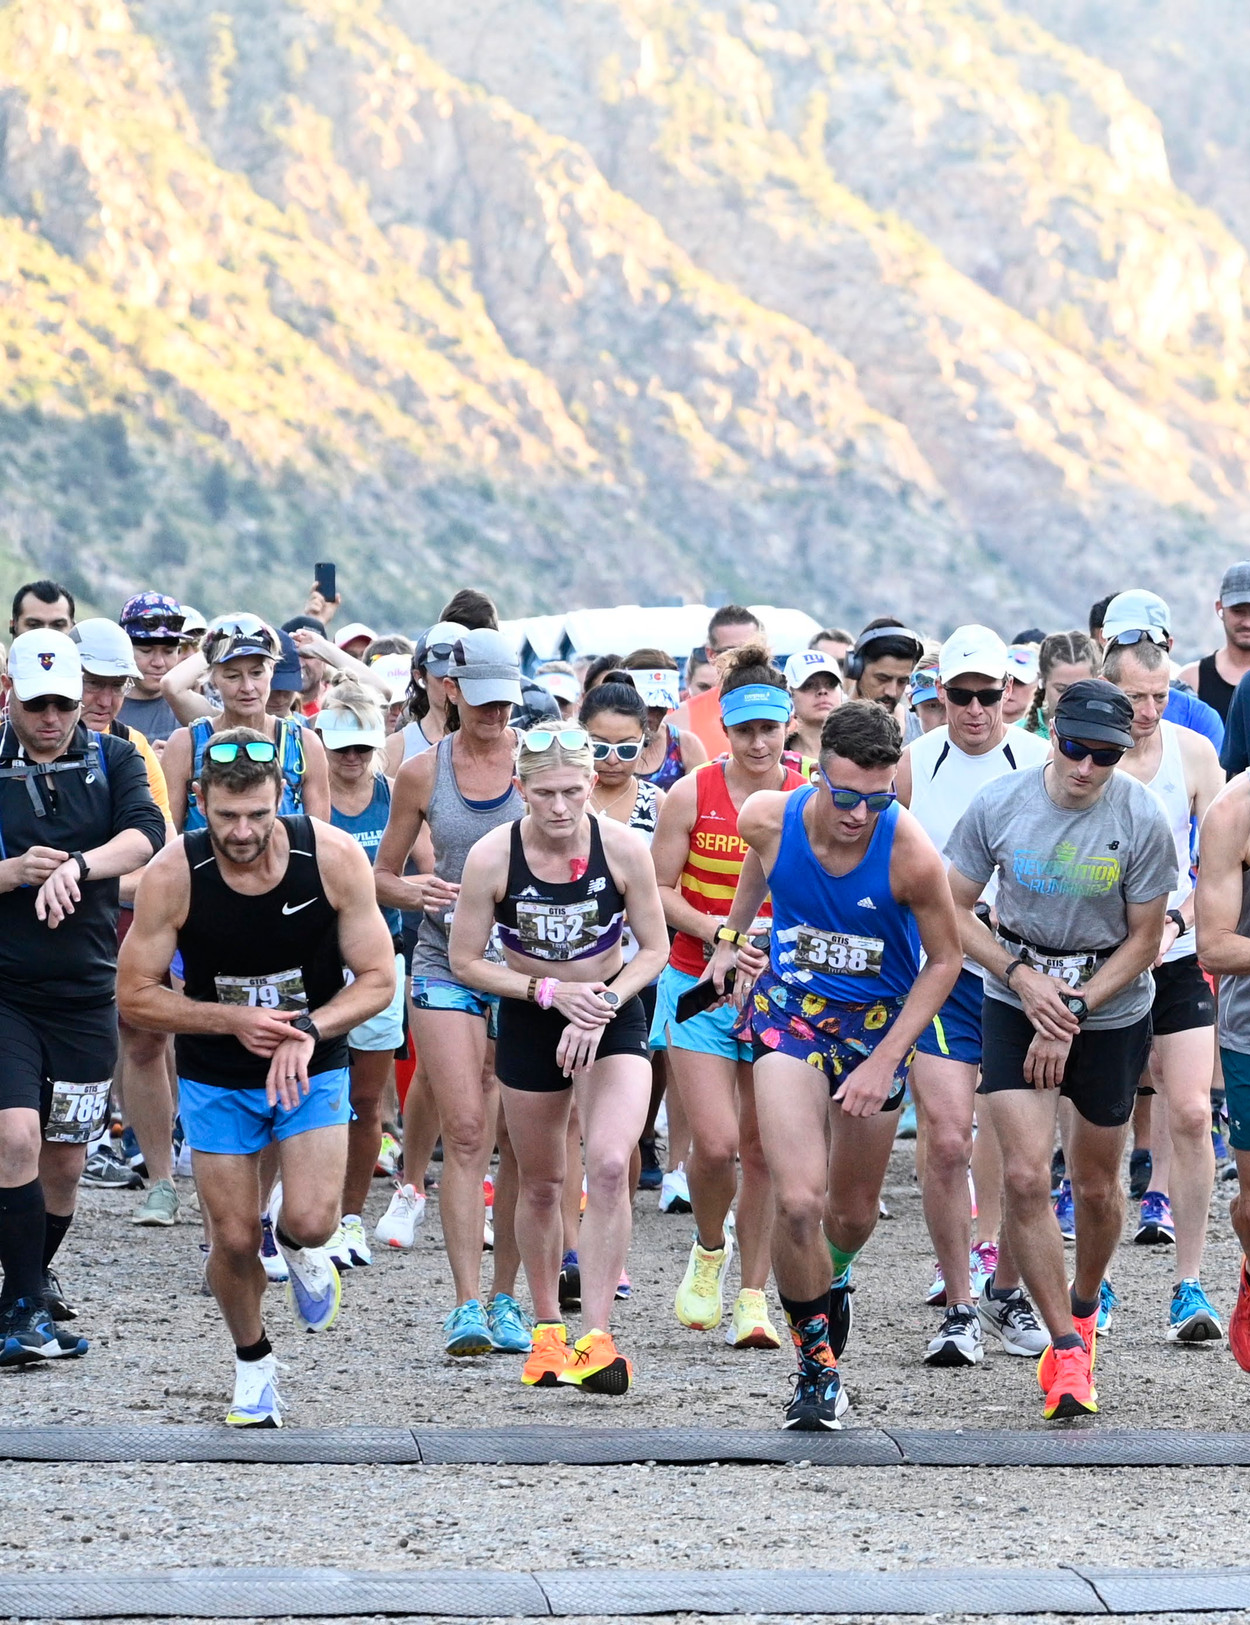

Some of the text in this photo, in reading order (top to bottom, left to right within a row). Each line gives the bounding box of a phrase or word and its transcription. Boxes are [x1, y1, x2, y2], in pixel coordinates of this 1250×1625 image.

[548, 907, 566, 915] GTIS
[532, 914, 584, 943] 152
[831, 935, 850, 945] GTIS
[808, 937, 868, 972] 338
[1046, 959, 1064, 967] GTIS
[242, 985, 280, 1009] 79
[64, 1093, 107, 1122] 785
